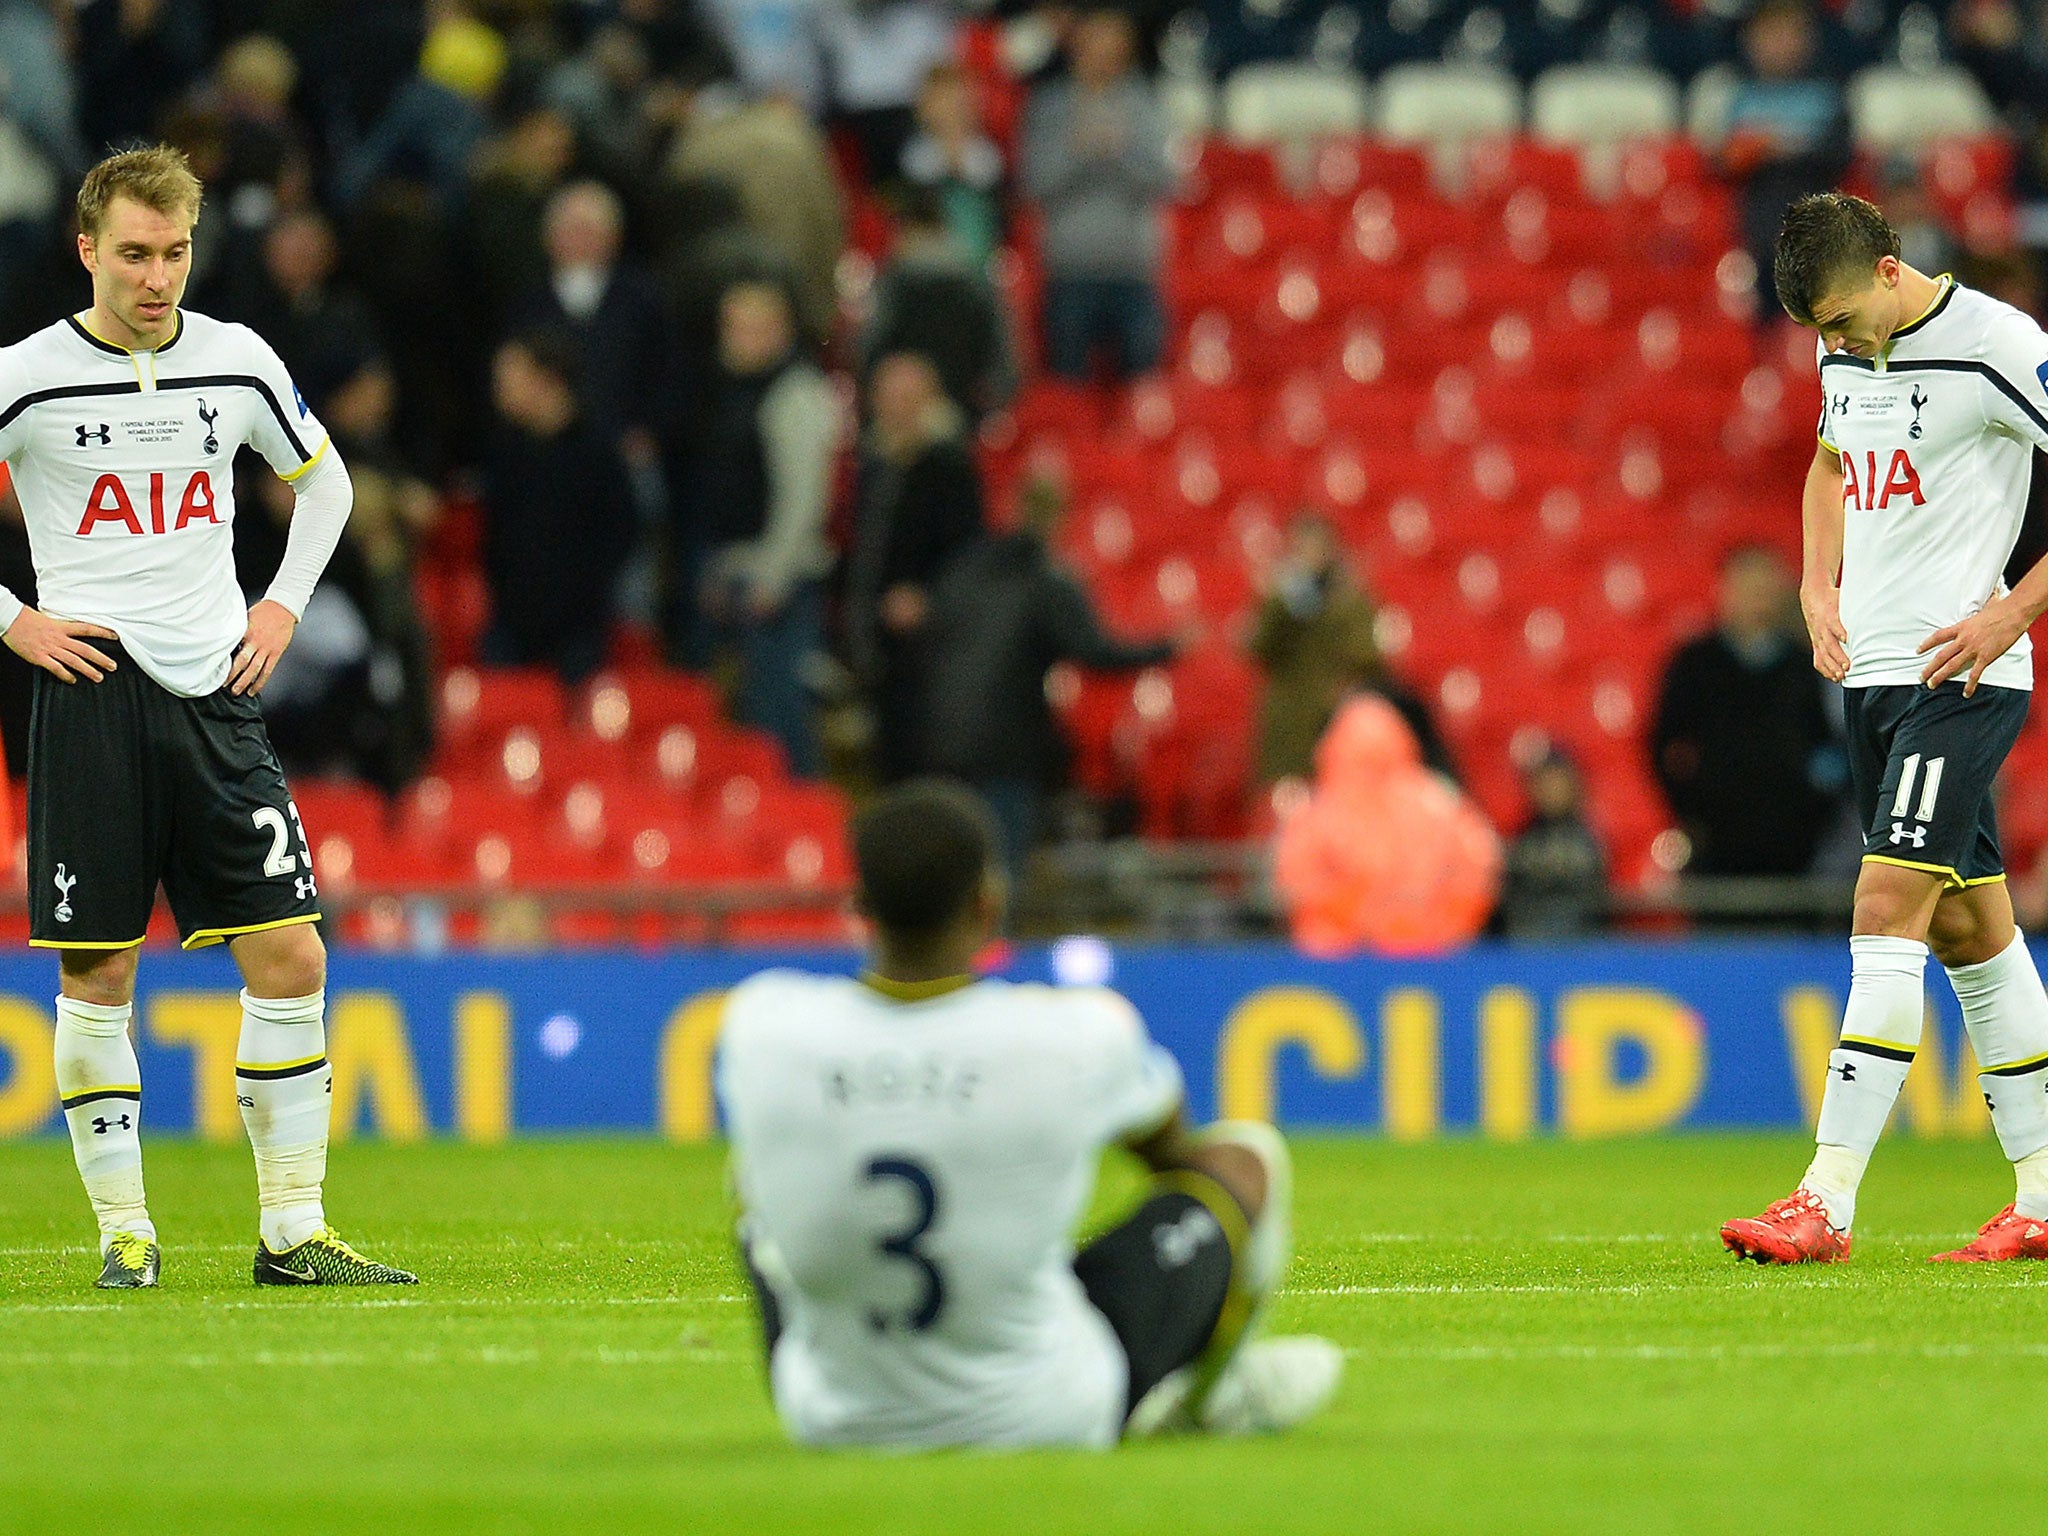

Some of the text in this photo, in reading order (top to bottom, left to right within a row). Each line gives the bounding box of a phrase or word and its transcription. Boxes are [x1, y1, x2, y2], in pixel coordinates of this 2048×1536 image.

[76, 470, 226, 535] AIA
[1842, 448, 1927, 511] AIA
[1890, 753, 1945, 823] 11
[863, 1154, 947, 1334] 3
